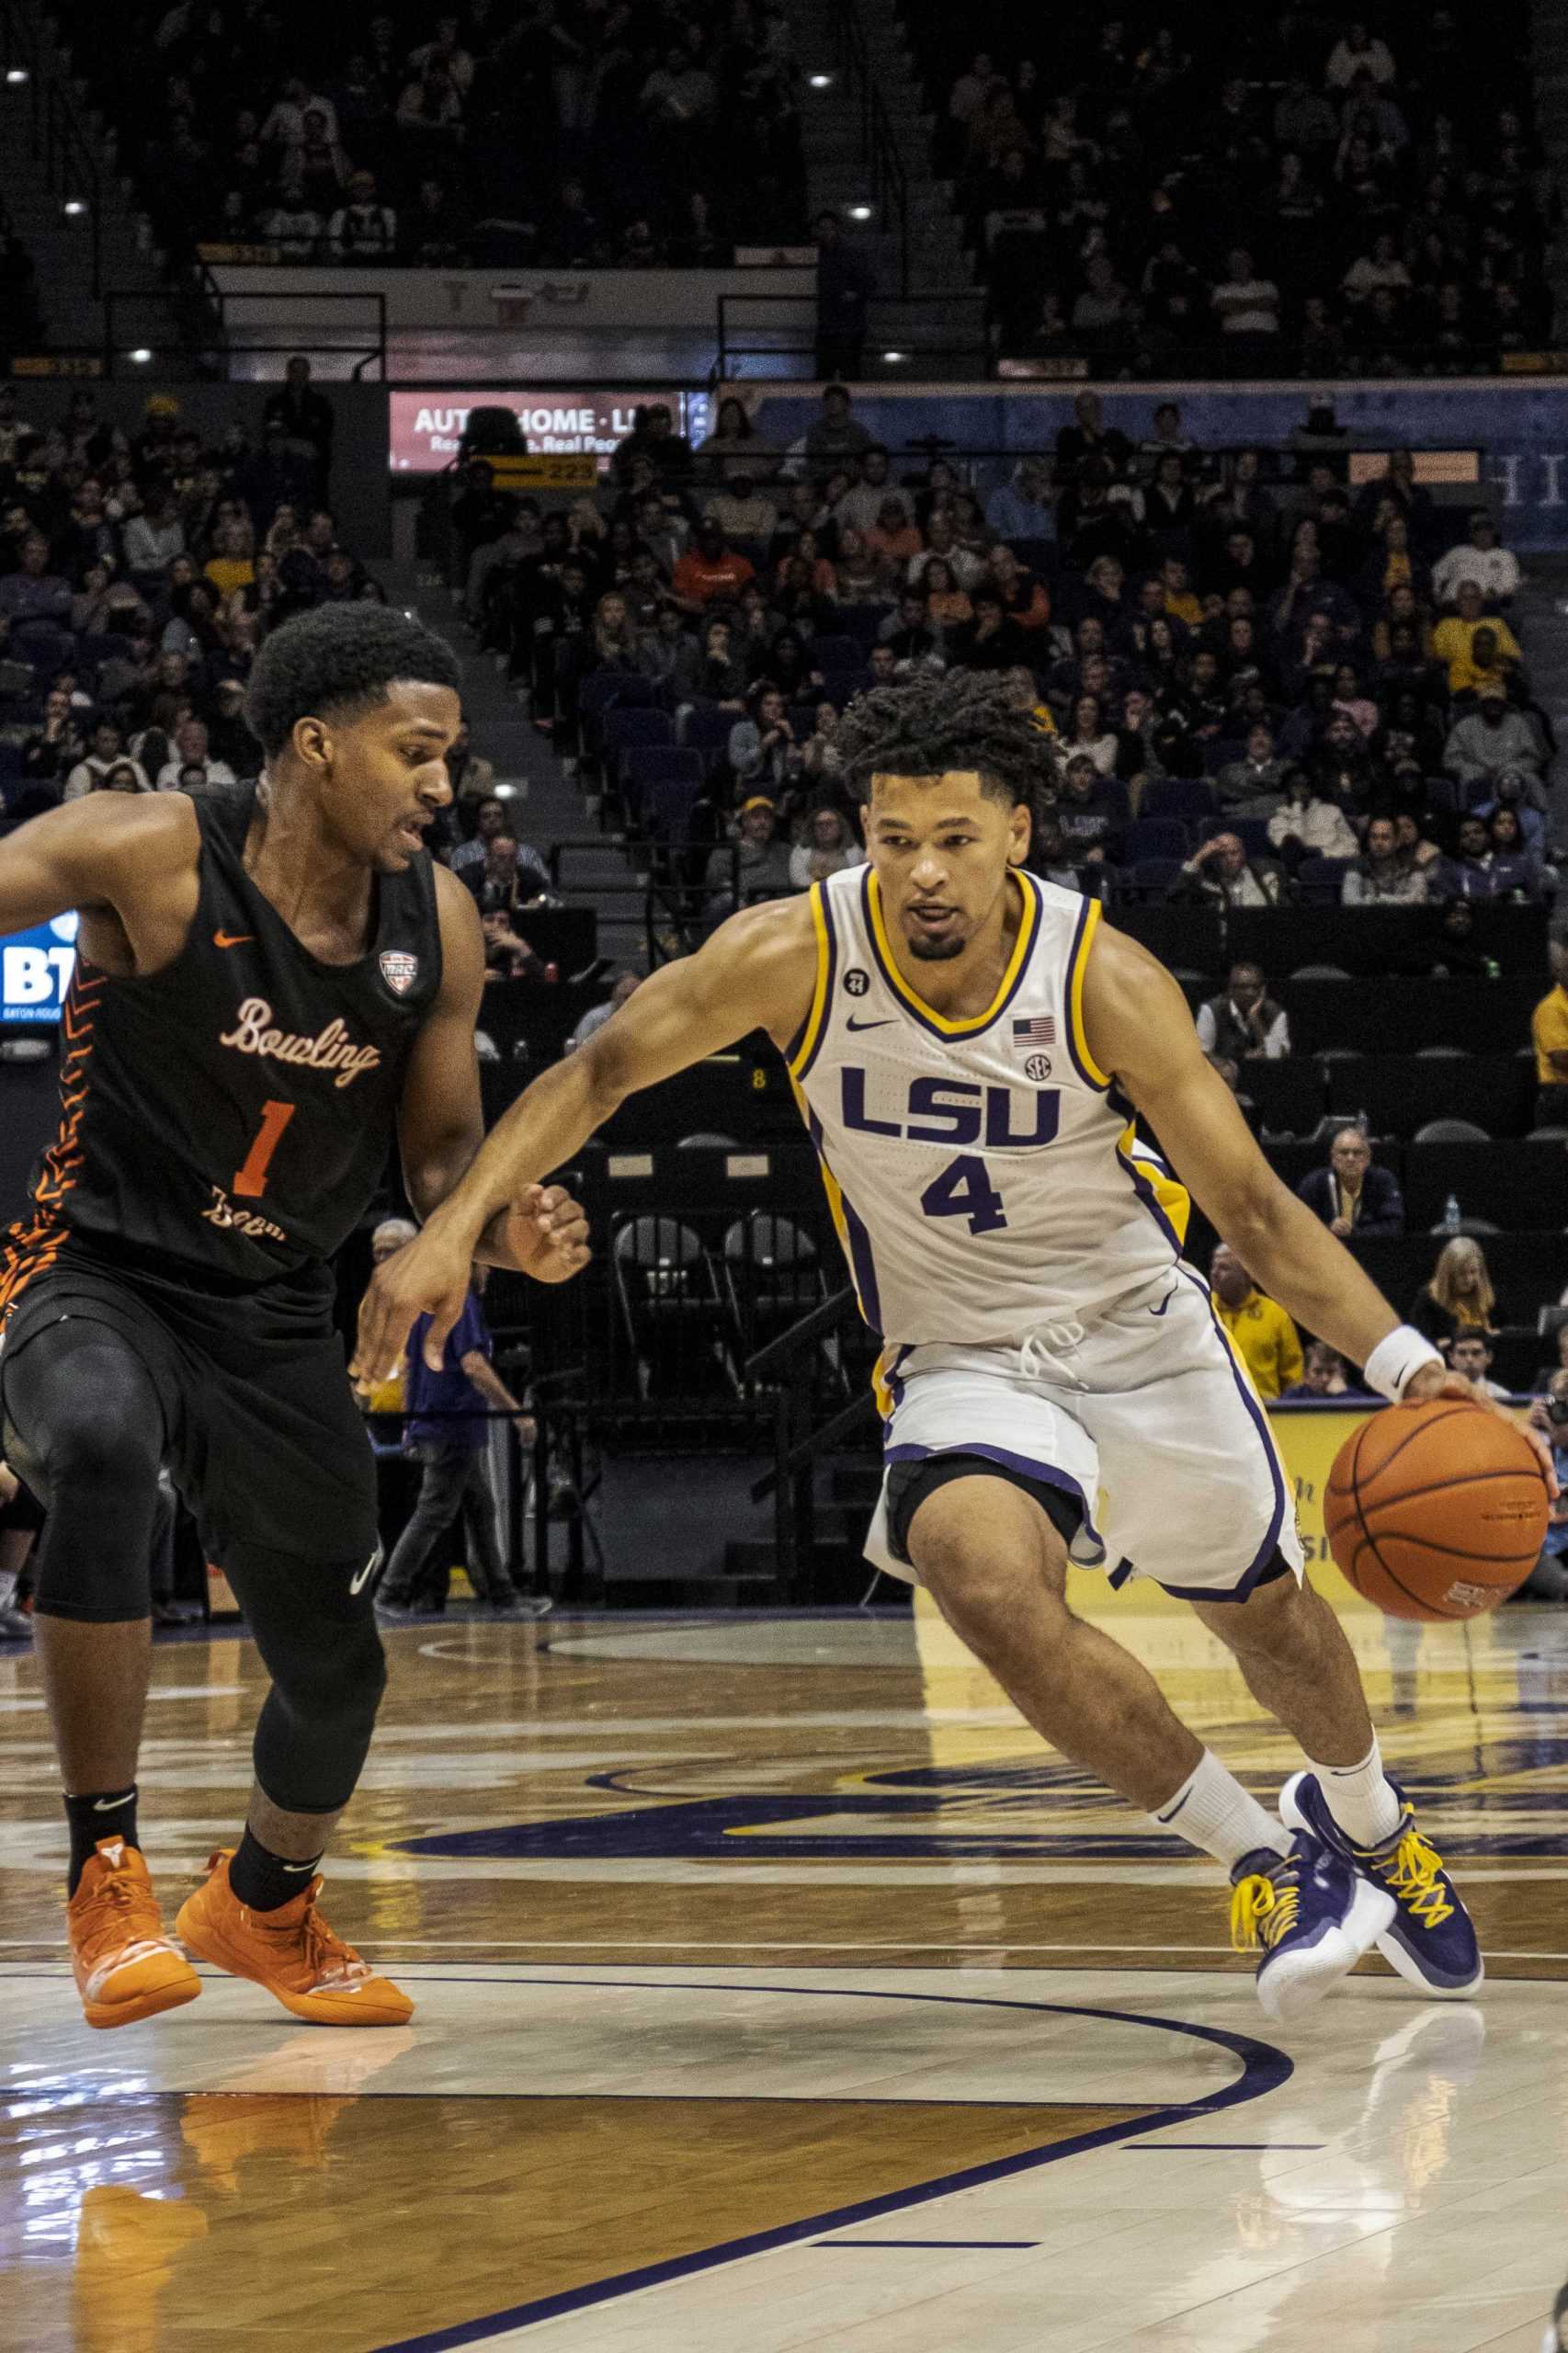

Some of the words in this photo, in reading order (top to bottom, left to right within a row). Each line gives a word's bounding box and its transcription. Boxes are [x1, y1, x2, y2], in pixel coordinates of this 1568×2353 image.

[414, 407, 470, 433] AUT
[517, 408, 596, 434] HOME
[612, 408, 636, 434] LI
[430, 436, 460, 452] Rea
[543, 435, 582, 453] Real
[585, 436, 620, 453] Peo
[550, 462, 594, 479] 223
[3, 946, 76, 1005] BT
[219, 997, 381, 1088] Bowling
[752, 1067, 767, 1089] 8
[1026, 1055, 1051, 1080] SEC
[841, 1067, 1061, 1147] LSU
[232, 1099, 296, 1199] 1
[920, 1154, 1007, 1234] 4
